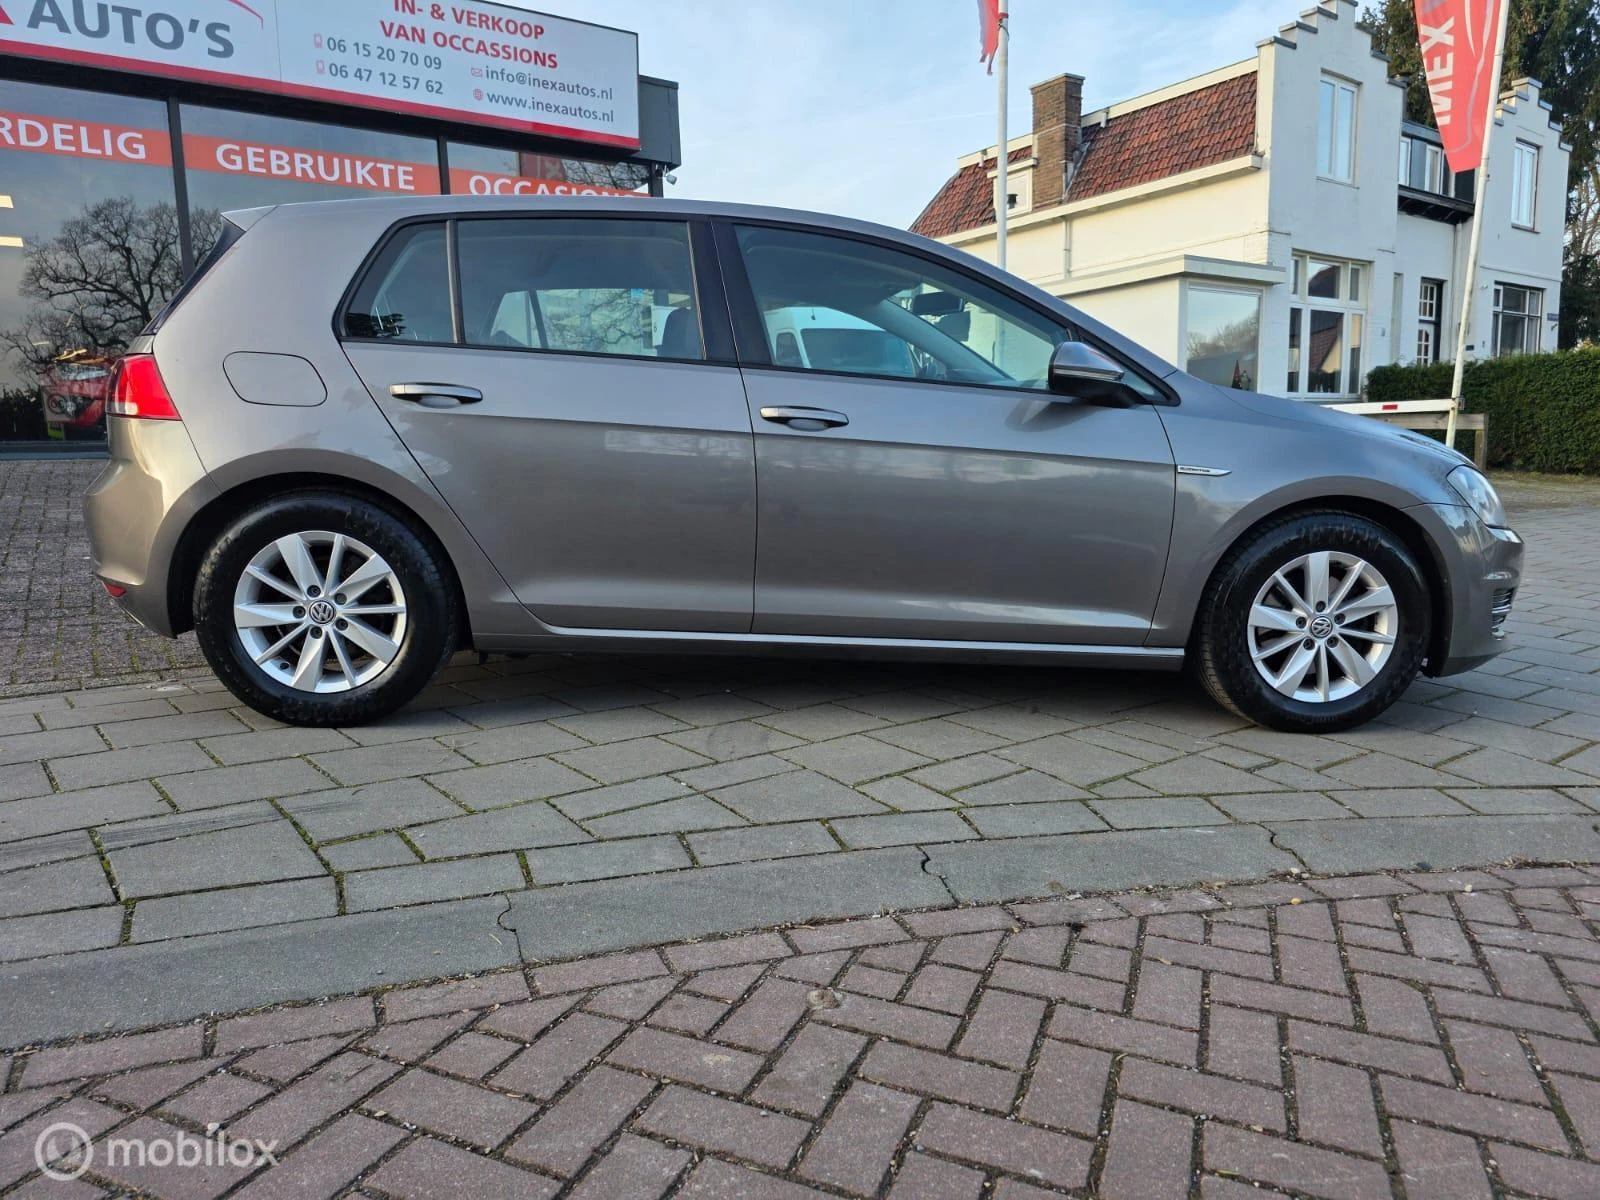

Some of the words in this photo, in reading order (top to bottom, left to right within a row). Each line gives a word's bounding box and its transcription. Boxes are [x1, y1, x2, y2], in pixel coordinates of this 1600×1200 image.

[27, 0, 235, 59] AUTO'S
[392, 0, 424, 16] IN-
[430, 3, 445, 22] &
[451, 6, 545, 40] VERKOOP
[327, 36, 347, 53] 06
[353, 42, 371, 58] 15
[376, 46, 396, 62] 20
[400, 50, 419, 67] 70
[423, 55, 442, 70] 09
[380, 20, 426, 44] VAN
[432, 31, 559, 69] OCCASSIONS
[329, 62, 349, 79] 06
[354, 67, 373, 83] 47
[379, 71, 397, 87] 12
[402, 75, 420, 90] 57
[425, 79, 443, 95] 62
[485, 66, 613, 100] info@inexautos.nl
[486, 92, 614, 122] www.inexautos.nl
[216, 143, 415, 191] GEBRUIKTE
